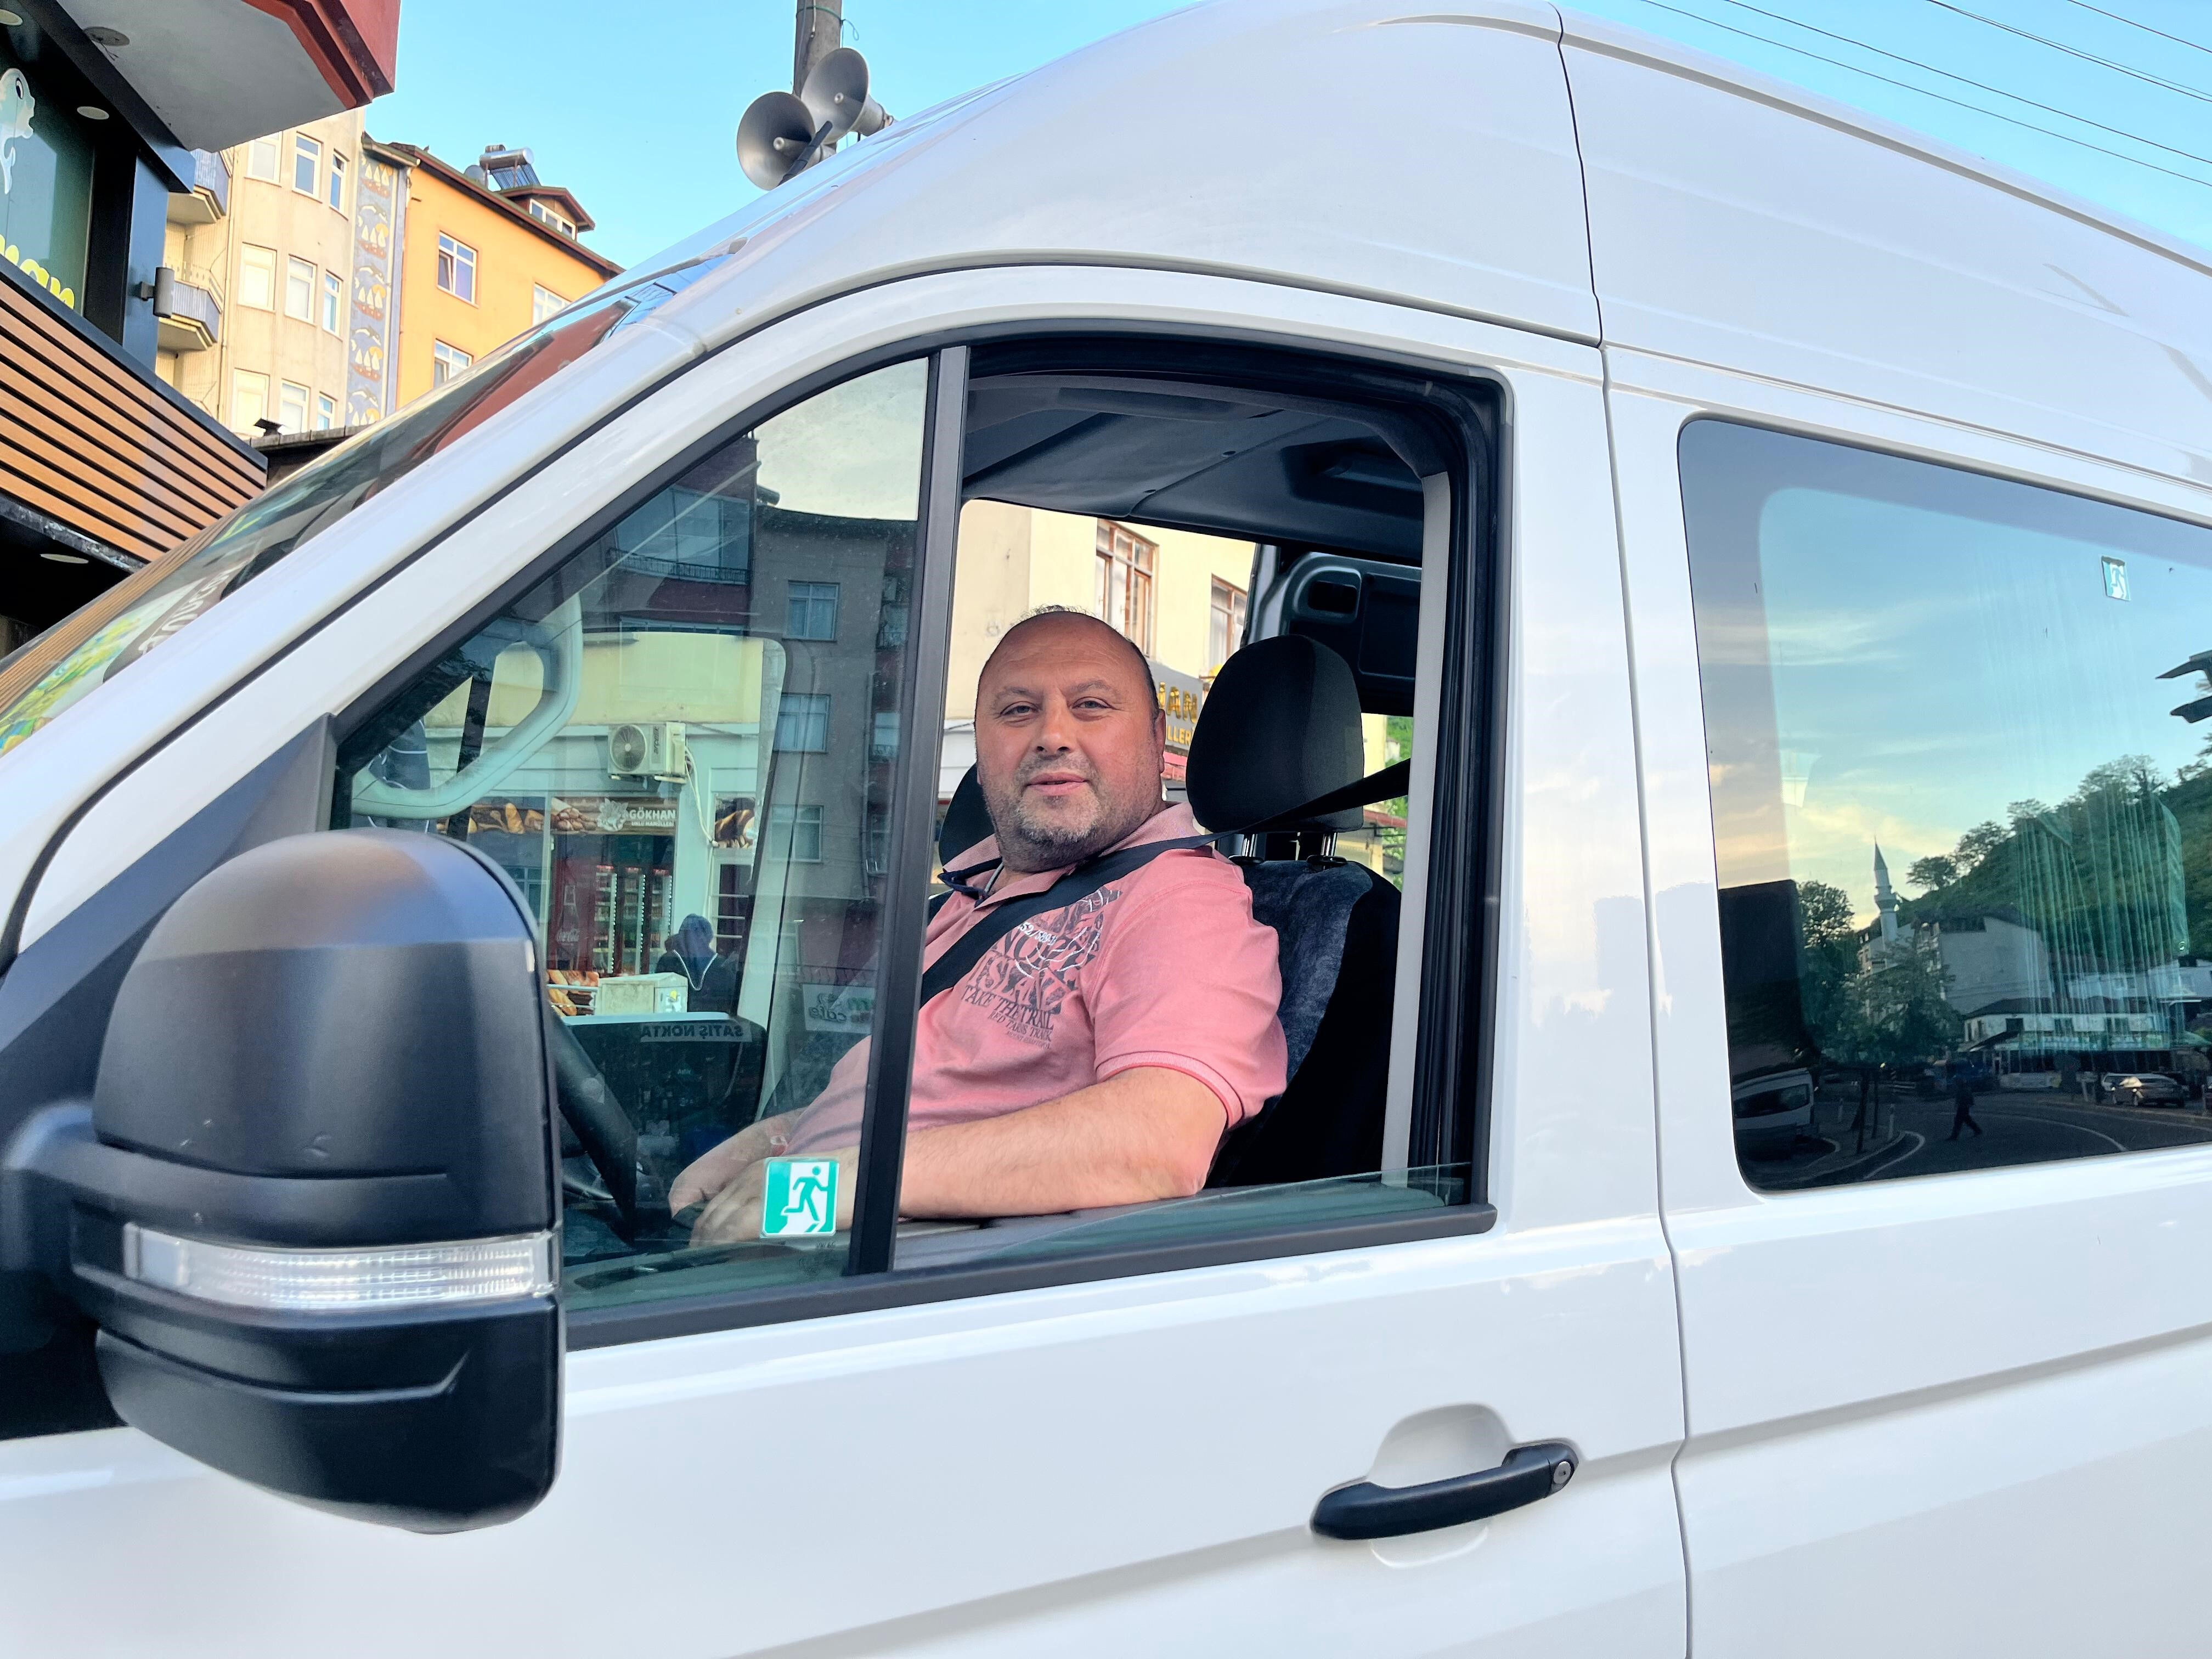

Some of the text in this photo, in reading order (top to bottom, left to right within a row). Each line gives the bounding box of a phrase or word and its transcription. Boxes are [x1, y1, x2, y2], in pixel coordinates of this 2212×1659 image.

[629, 806, 676, 820] GÖKHAN
[961, 984, 1054, 1030] TAKE THE TRAIL
